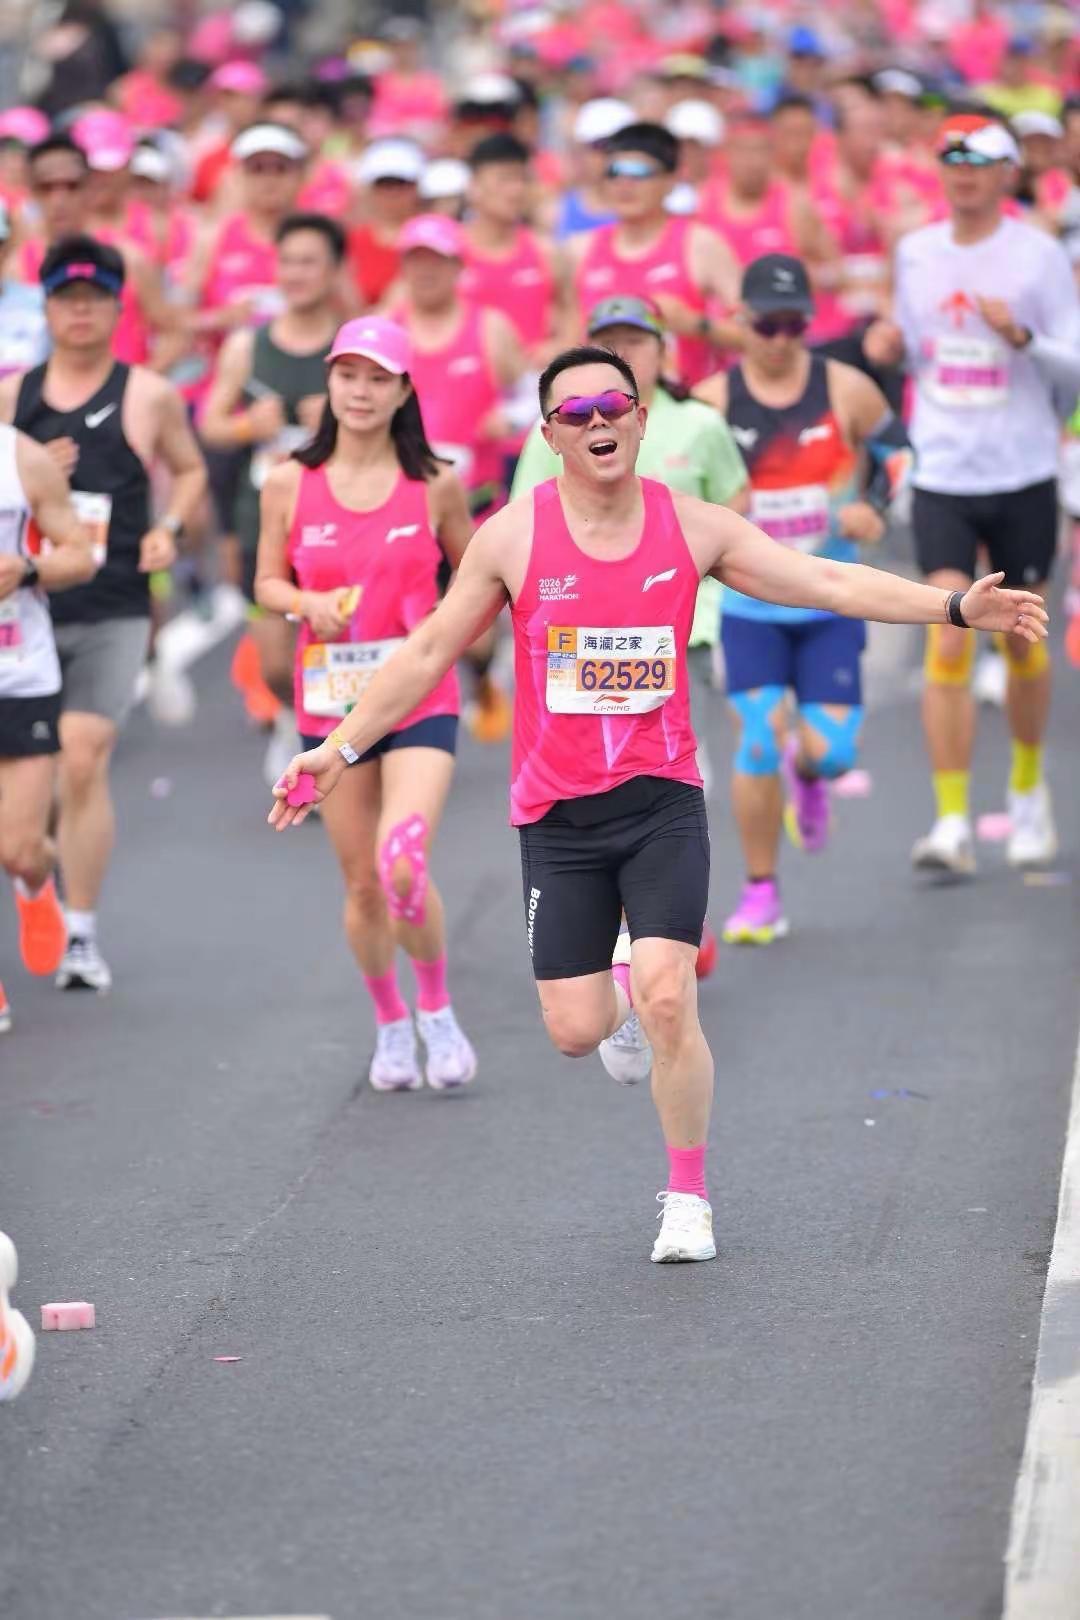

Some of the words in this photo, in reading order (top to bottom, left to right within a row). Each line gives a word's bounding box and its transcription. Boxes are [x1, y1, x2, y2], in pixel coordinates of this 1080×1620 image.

[538, 578, 561, 588] 2026
[539, 587, 561, 595] WUXI
[559, 632, 573, 650] F
[583, 635, 643, 651] 海澜之家
[581, 660, 666, 691] 62529
